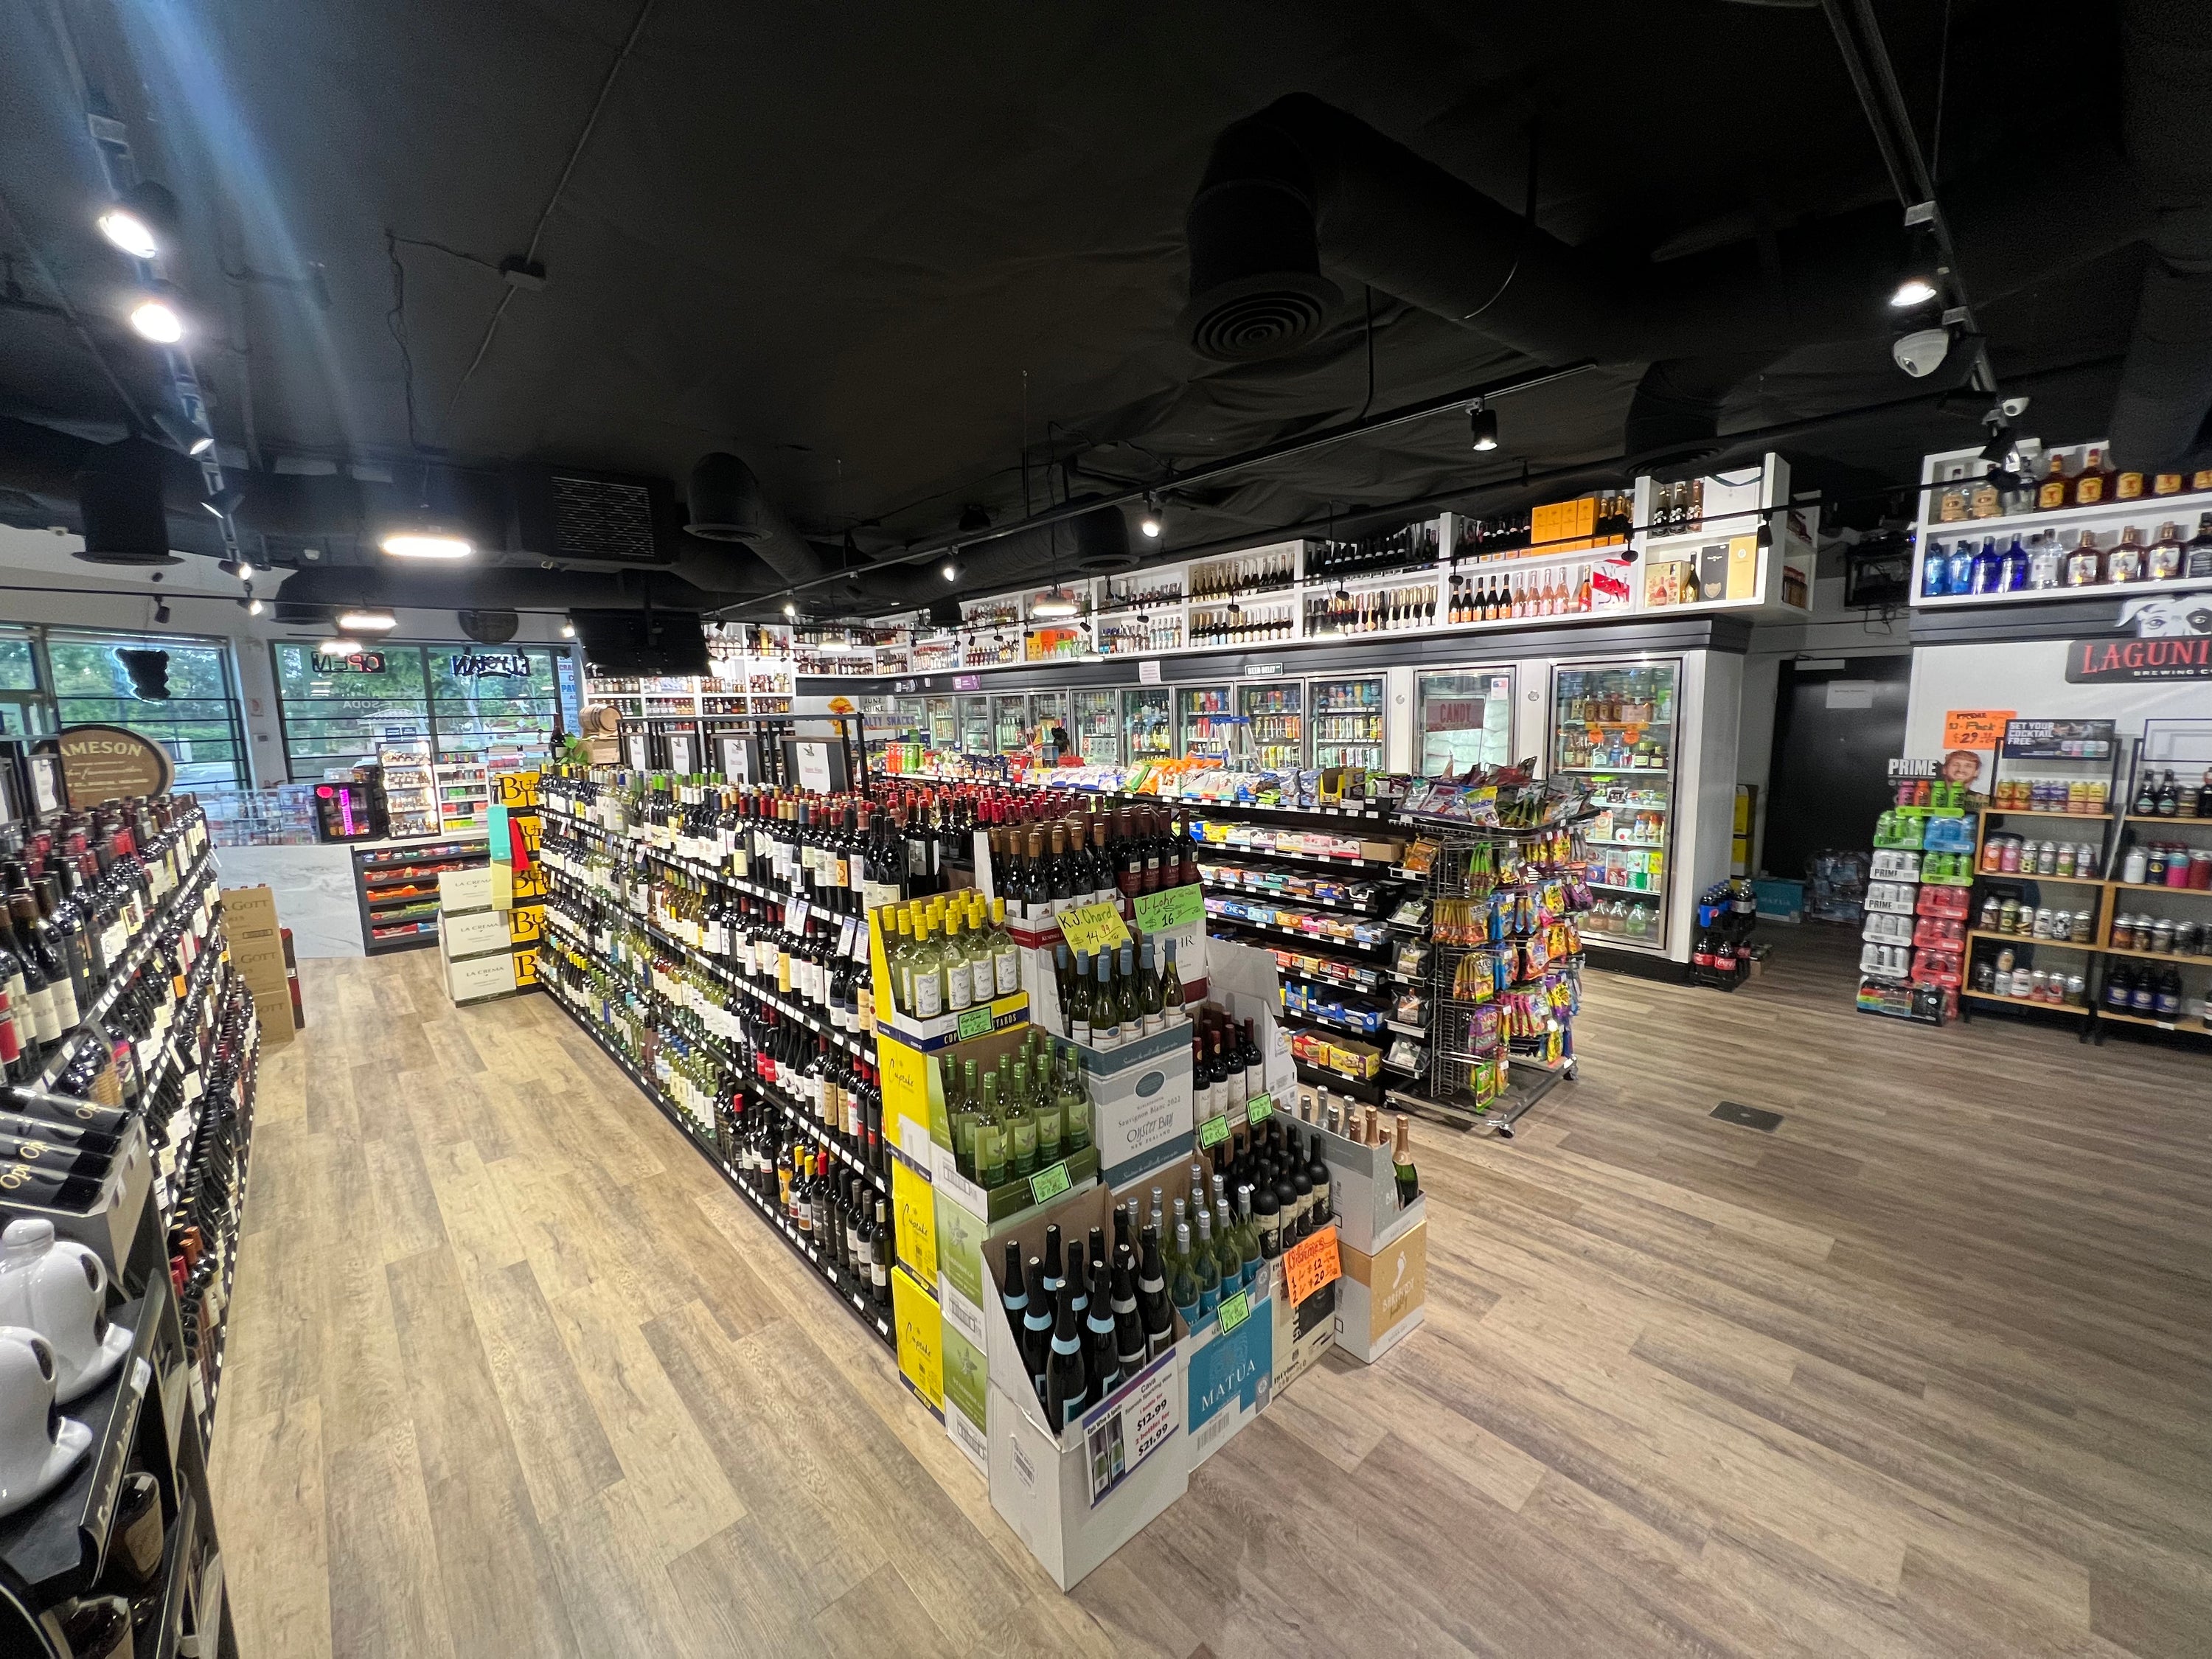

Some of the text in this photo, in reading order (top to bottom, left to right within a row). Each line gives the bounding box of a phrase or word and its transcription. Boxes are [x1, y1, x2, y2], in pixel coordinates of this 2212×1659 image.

[864, 715, 915, 726] ALTY SNACKS
[1440, 703, 1472, 723] CANDY
[2008, 730, 2053, 738] COCKTAIL
[2009, 722, 2055, 730] SET YOUR
[60, 741, 143, 757] AMESON
[2007, 737, 2032, 745] FREE
[1888, 759, 1938, 776] PRIME
[1225, 905, 1239, 914] ONE
[1868, 900, 1893, 910] PRIME
[472, 922, 499, 931] CREMA
[477, 966, 504, 975] CREMA
[888, 1058, 914, 1088] Cupcake
[1118, 1109, 1149, 1128] Sauvignon
[1150, 1102, 1166, 1113] Blanc
[1130, 1129, 1172, 1150] NEW ZEALAND
[902, 1203, 929, 1237] Cupcake
[905, 1321, 932, 1358] Cupcake
[1141, 1377, 1156, 1394] Cava
[1201, 1358, 1256, 1412] MATUA
[1125, 1398, 1142, 1415] Spanish
[1137, 1399, 1167, 1431] $12.99
[1140, 1419, 1161, 1441] bottles
[1161, 1411, 1170, 1422] for
[1138, 1423, 1168, 1457] $21.99
